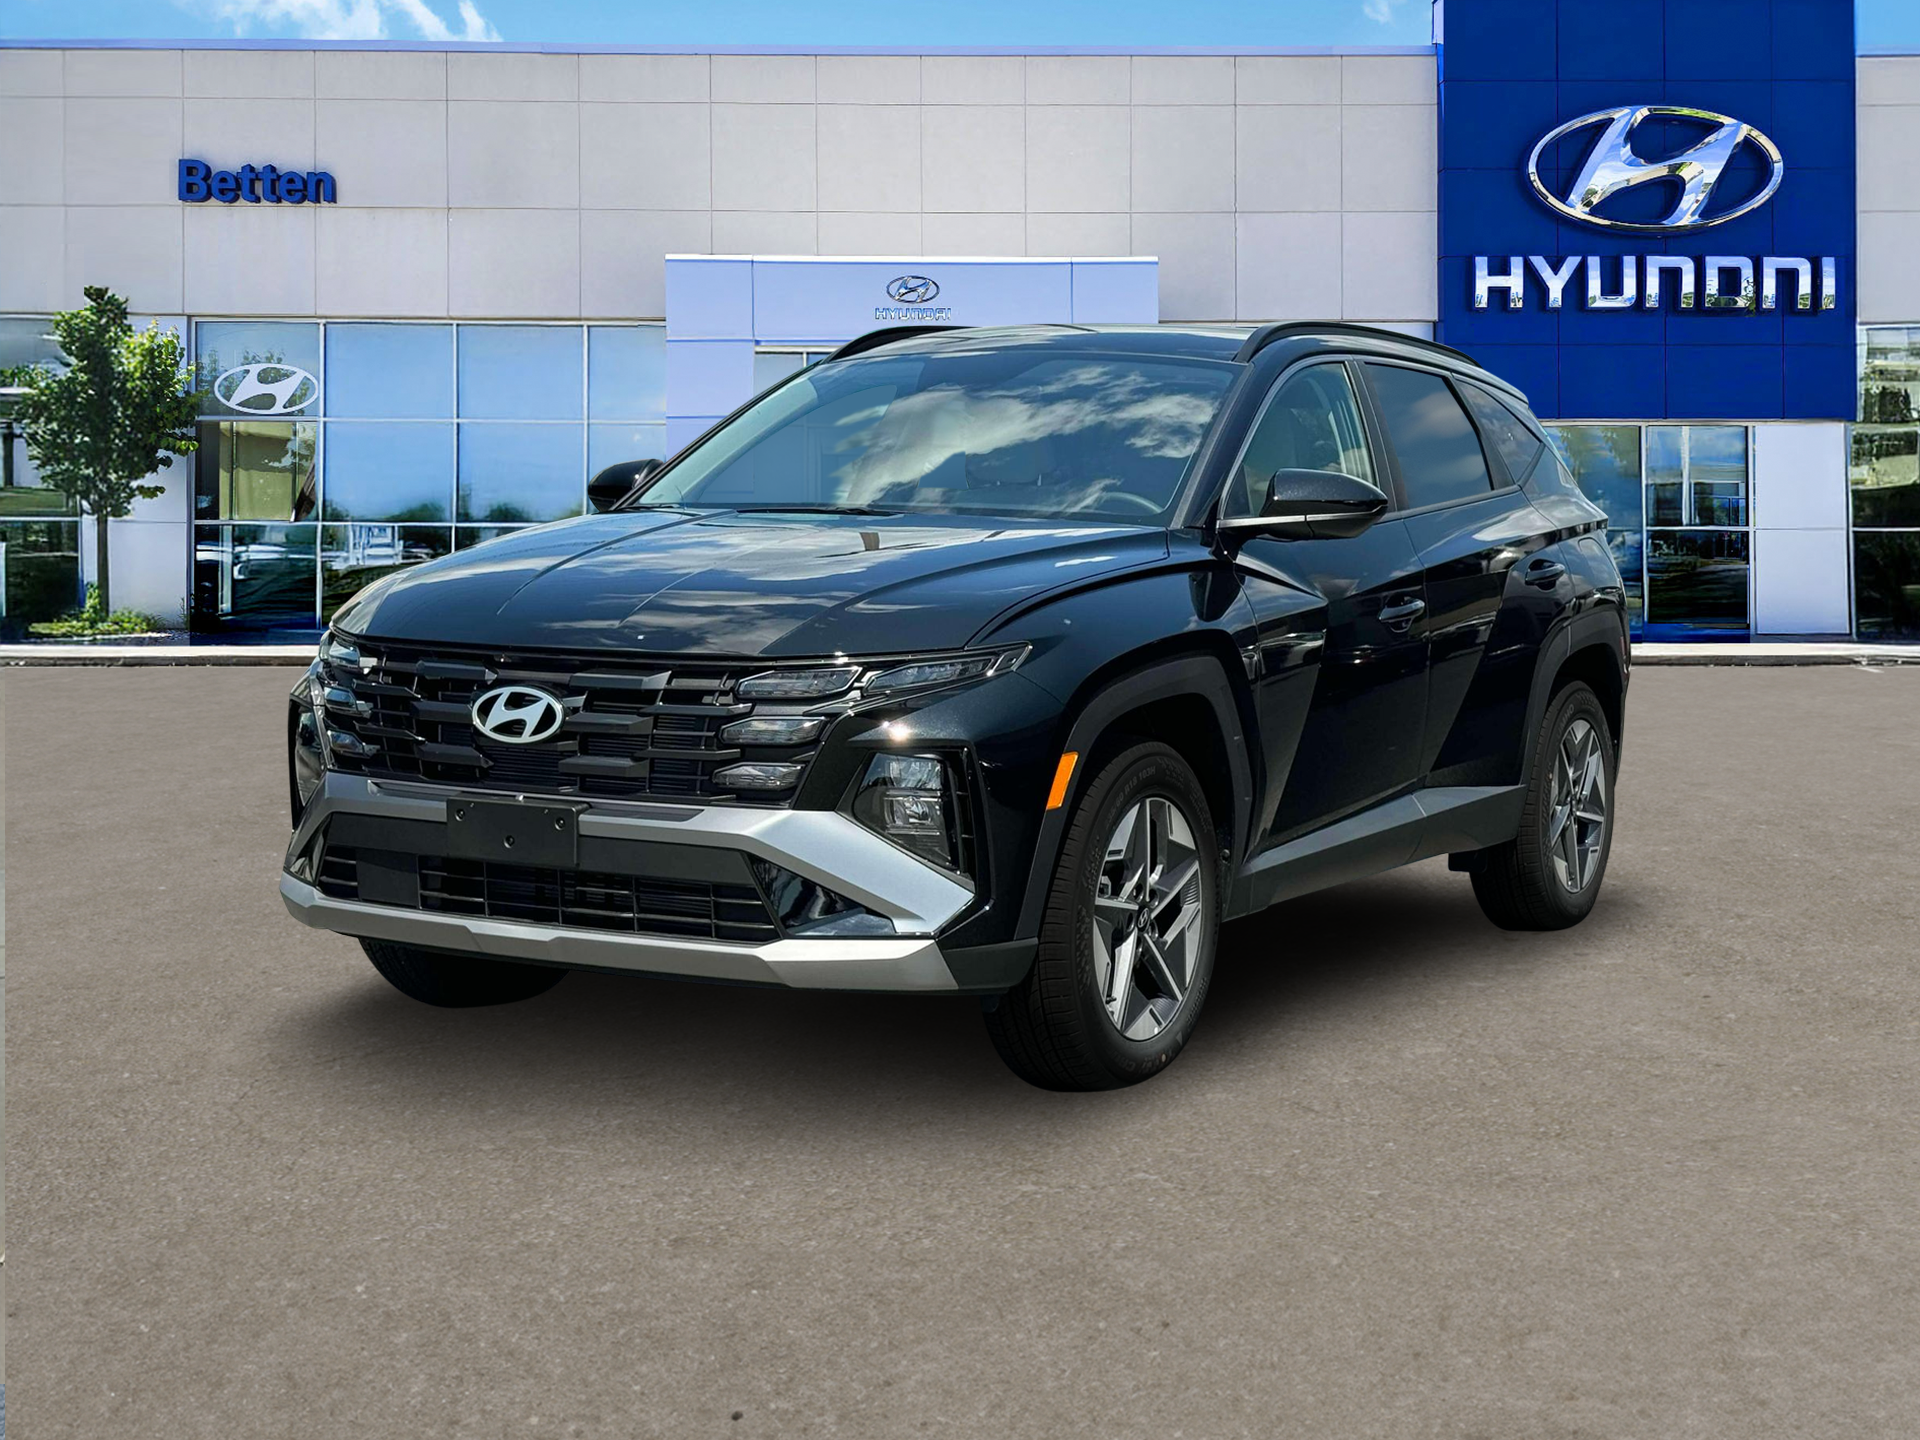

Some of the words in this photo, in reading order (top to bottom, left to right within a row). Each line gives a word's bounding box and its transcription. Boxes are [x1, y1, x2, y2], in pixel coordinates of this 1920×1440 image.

[178, 159, 337, 204] Betten
[1474, 255, 1836, 309] HYUNDAI
[875, 307, 951, 320] HYUNDAI
